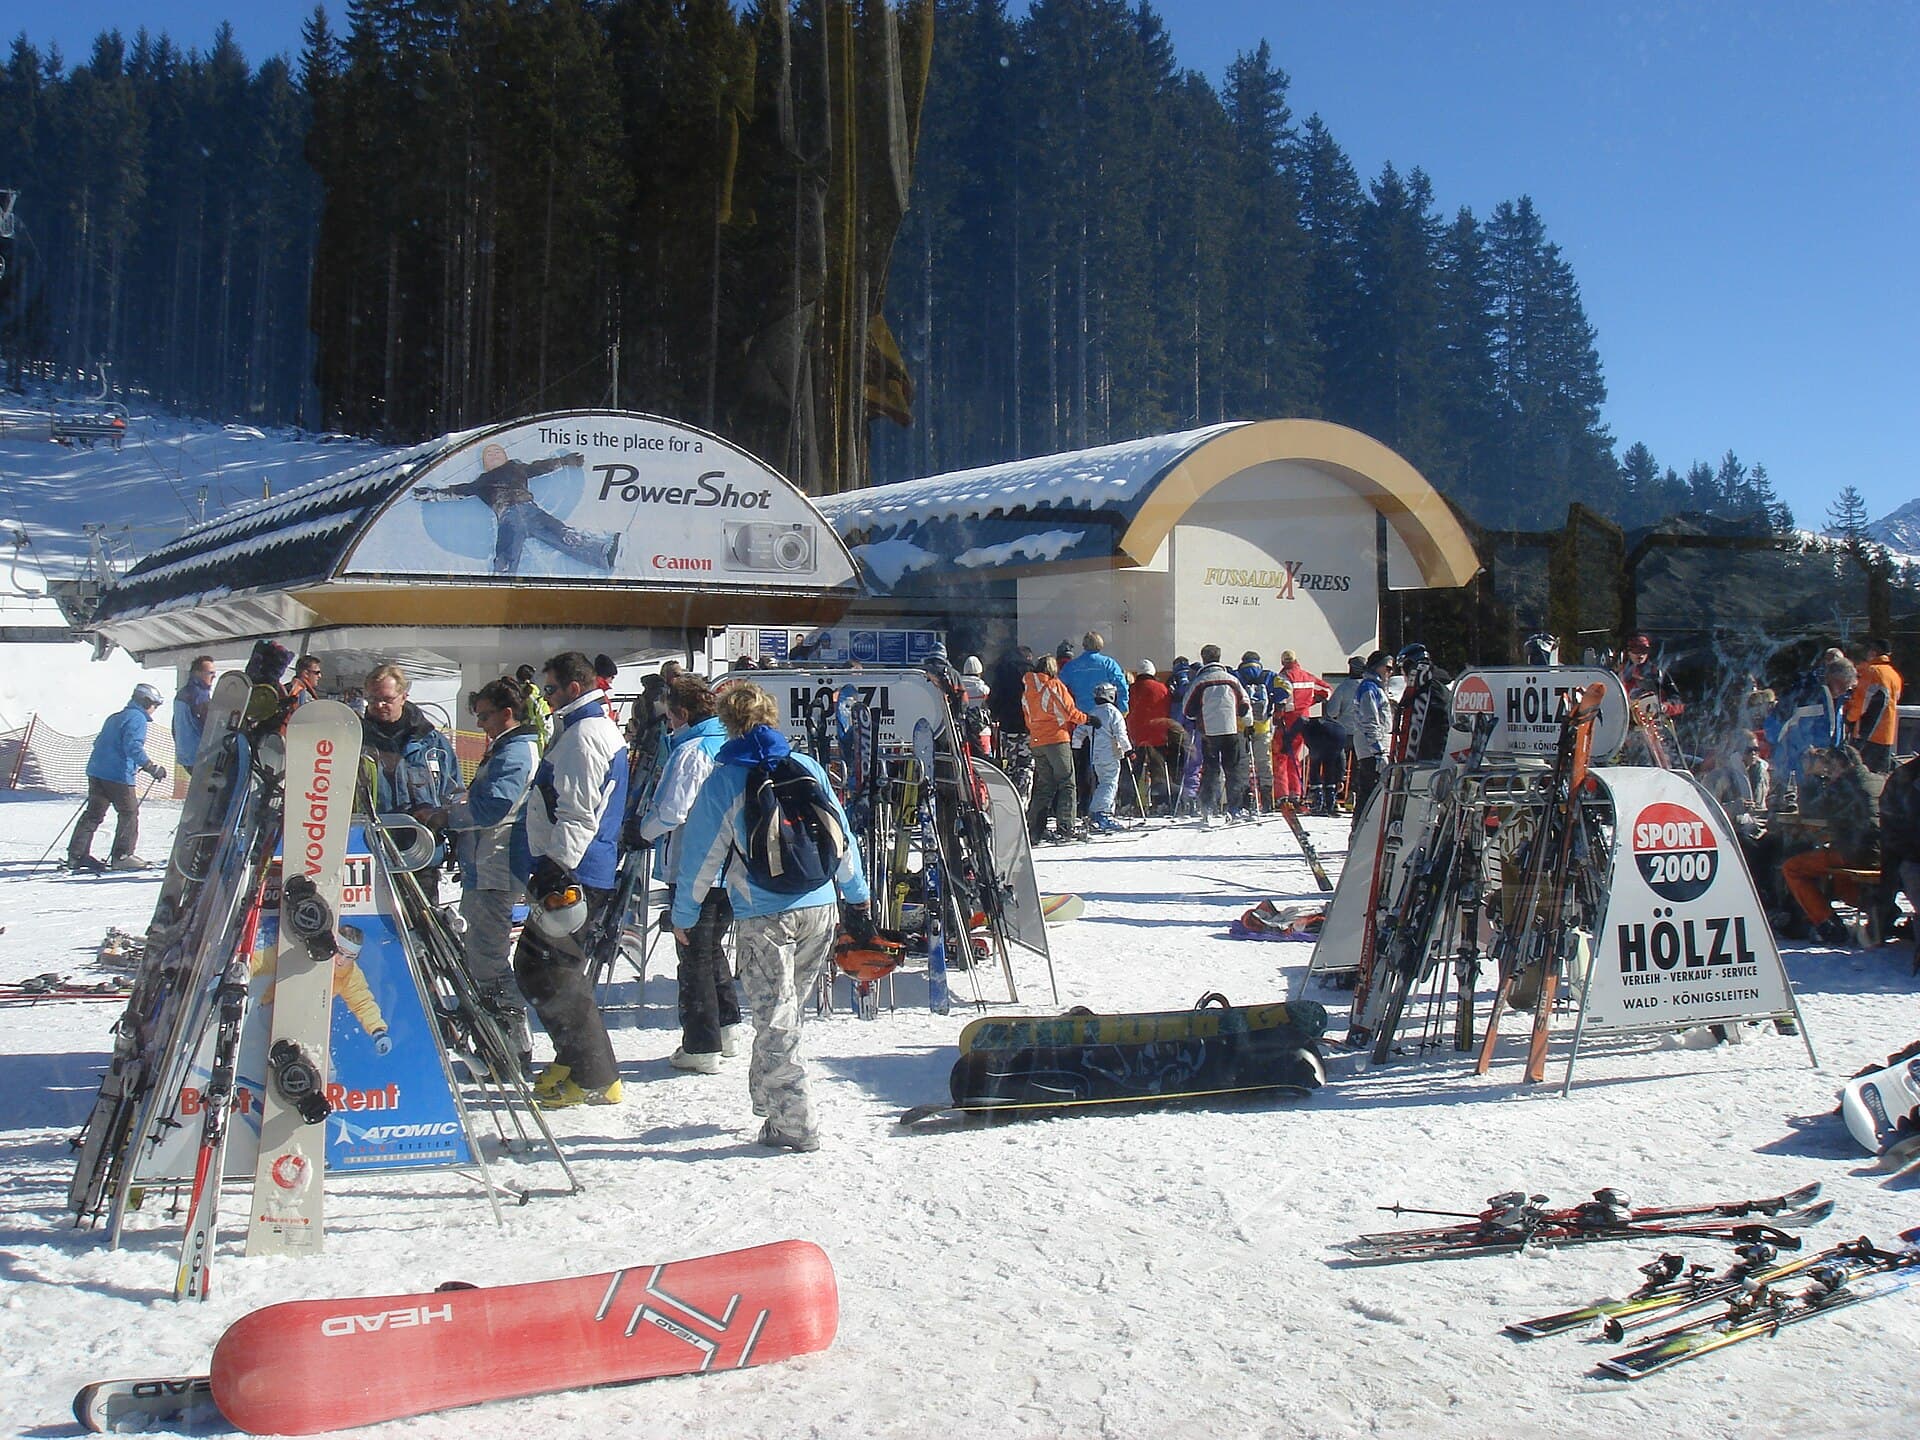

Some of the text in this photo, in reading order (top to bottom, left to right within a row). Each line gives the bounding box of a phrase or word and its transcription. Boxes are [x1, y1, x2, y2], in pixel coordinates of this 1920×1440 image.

[538, 428, 703, 453] This is the place for a
[592, 463, 771, 510] PowerShot
[652, 554, 712, 571] Canon
[1456, 691, 1490, 711] SPORT
[302, 739, 334, 876] vodafone
[1636, 822, 1704, 849] SPORT
[1649, 854, 1711, 884] 2000
[1618, 906, 1756, 973] HÖLZL
[1622, 973, 1661, 986] VERLEIH
[1670, 969, 1713, 983] VERKAUF
[1721, 965, 1758, 979] SERVICE
[1623, 997, 1658, 1010] WALD
[1672, 988, 1759, 1006] KÖNIGSLEITEN
[326, 1083, 399, 1112] Rent
[360, 1121, 458, 1140] ATOMIC
[321, 1303, 453, 1337] HEAD
[655, 1318, 702, 1344] HEAD
[132, 1378, 210, 1398] EAD
